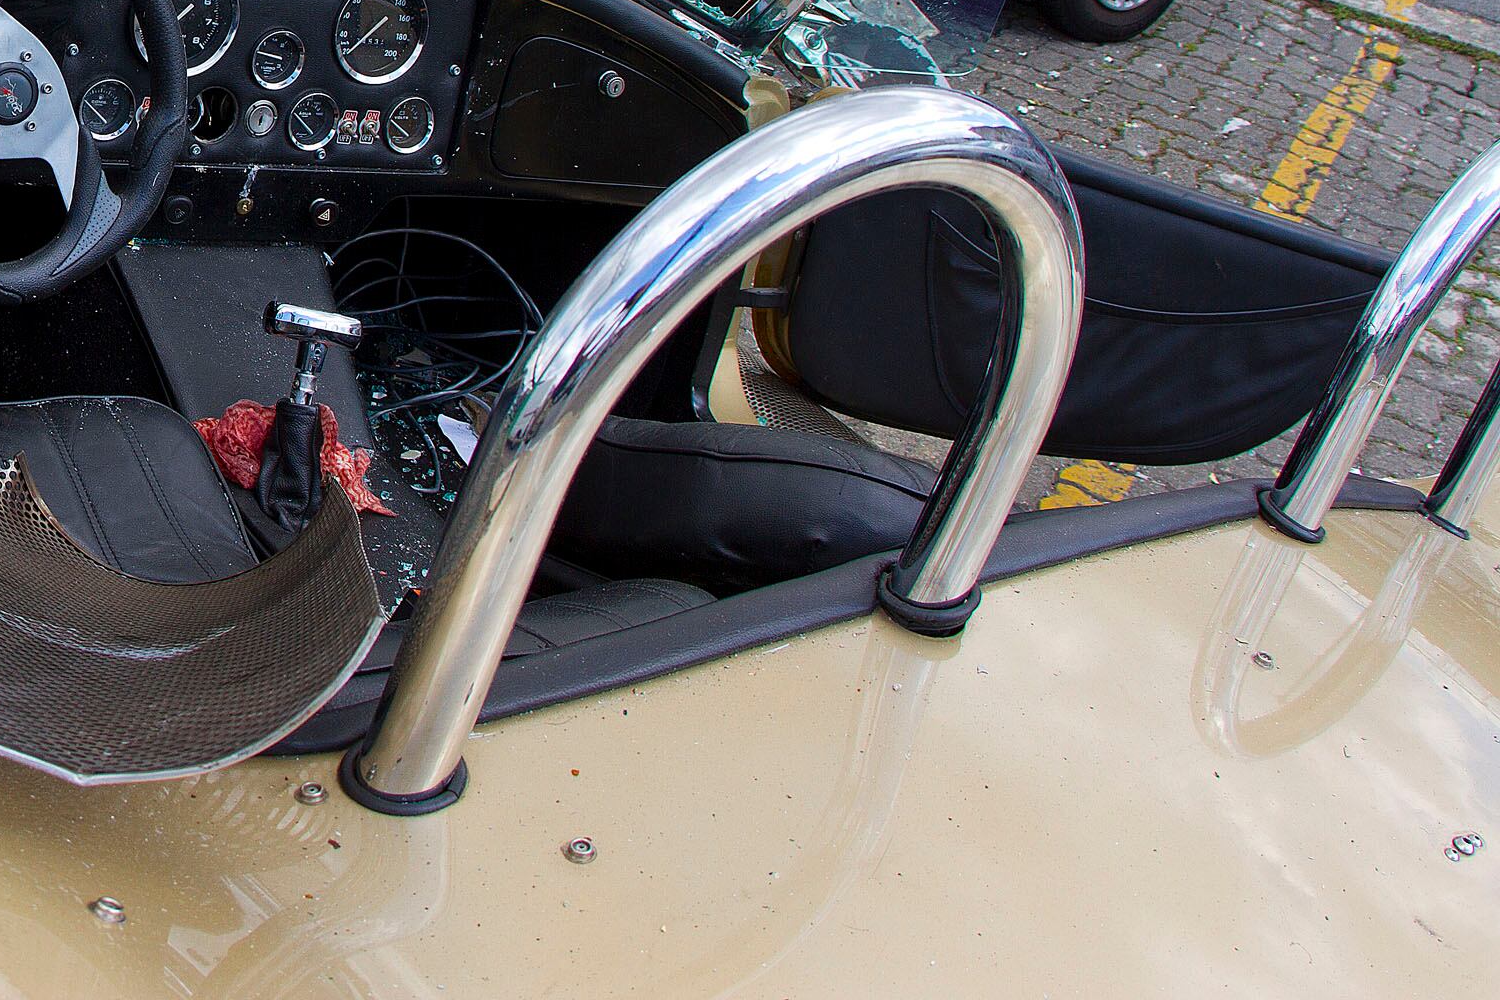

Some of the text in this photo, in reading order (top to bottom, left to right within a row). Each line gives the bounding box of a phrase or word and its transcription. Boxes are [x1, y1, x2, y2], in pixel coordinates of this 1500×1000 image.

[394, 0, 407, 7] 140
[205, 18, 213, 26] 7
[399, 14, 411, 22] 160
[192, 36, 200, 44] 8
[396, 33, 408, 41] 180
[384, 50, 398, 58] 200
[345, 112, 356, 120] ON
[367, 112, 378, 120] ON
